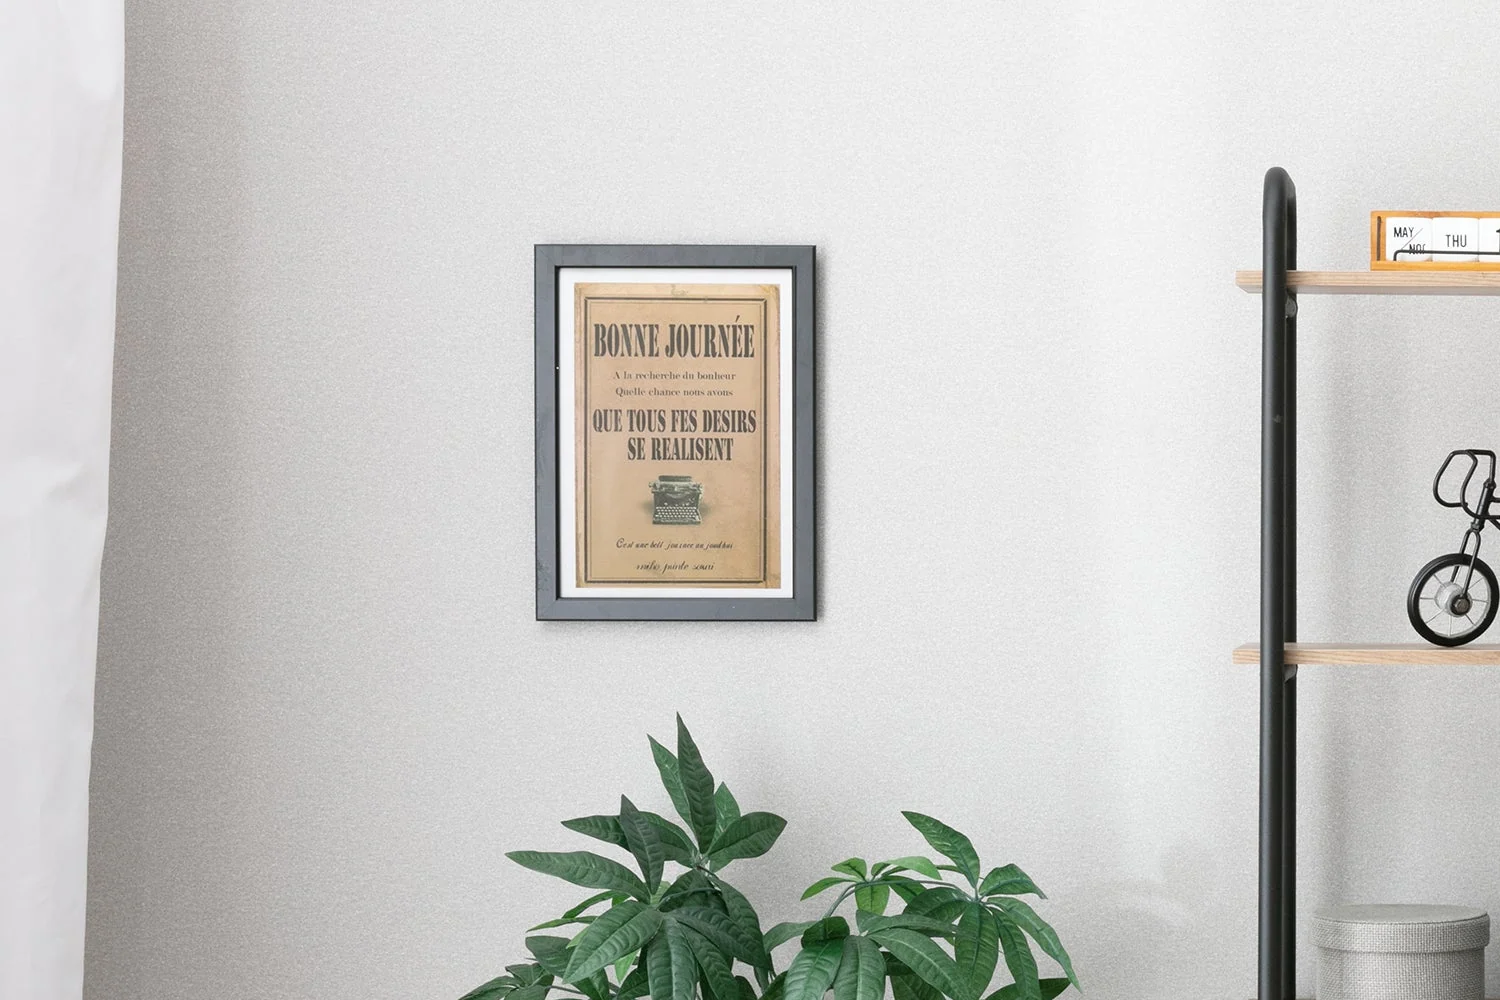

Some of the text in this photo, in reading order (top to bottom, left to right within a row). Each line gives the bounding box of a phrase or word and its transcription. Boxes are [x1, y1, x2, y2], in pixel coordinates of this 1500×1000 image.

[1393, 226, 1415, 238] MAY
[1445, 234, 1468, 248] THU
[594, 315, 755, 358] BONNE JOURNÉE
[613, 371, 737, 380] A la recherche du bonheur
[615, 387, 734, 397] Quelle chance nous avons
[592, 409, 757, 433] QUE TOUS FES DESIRS
[627, 437, 734, 461] SE REALISENT
